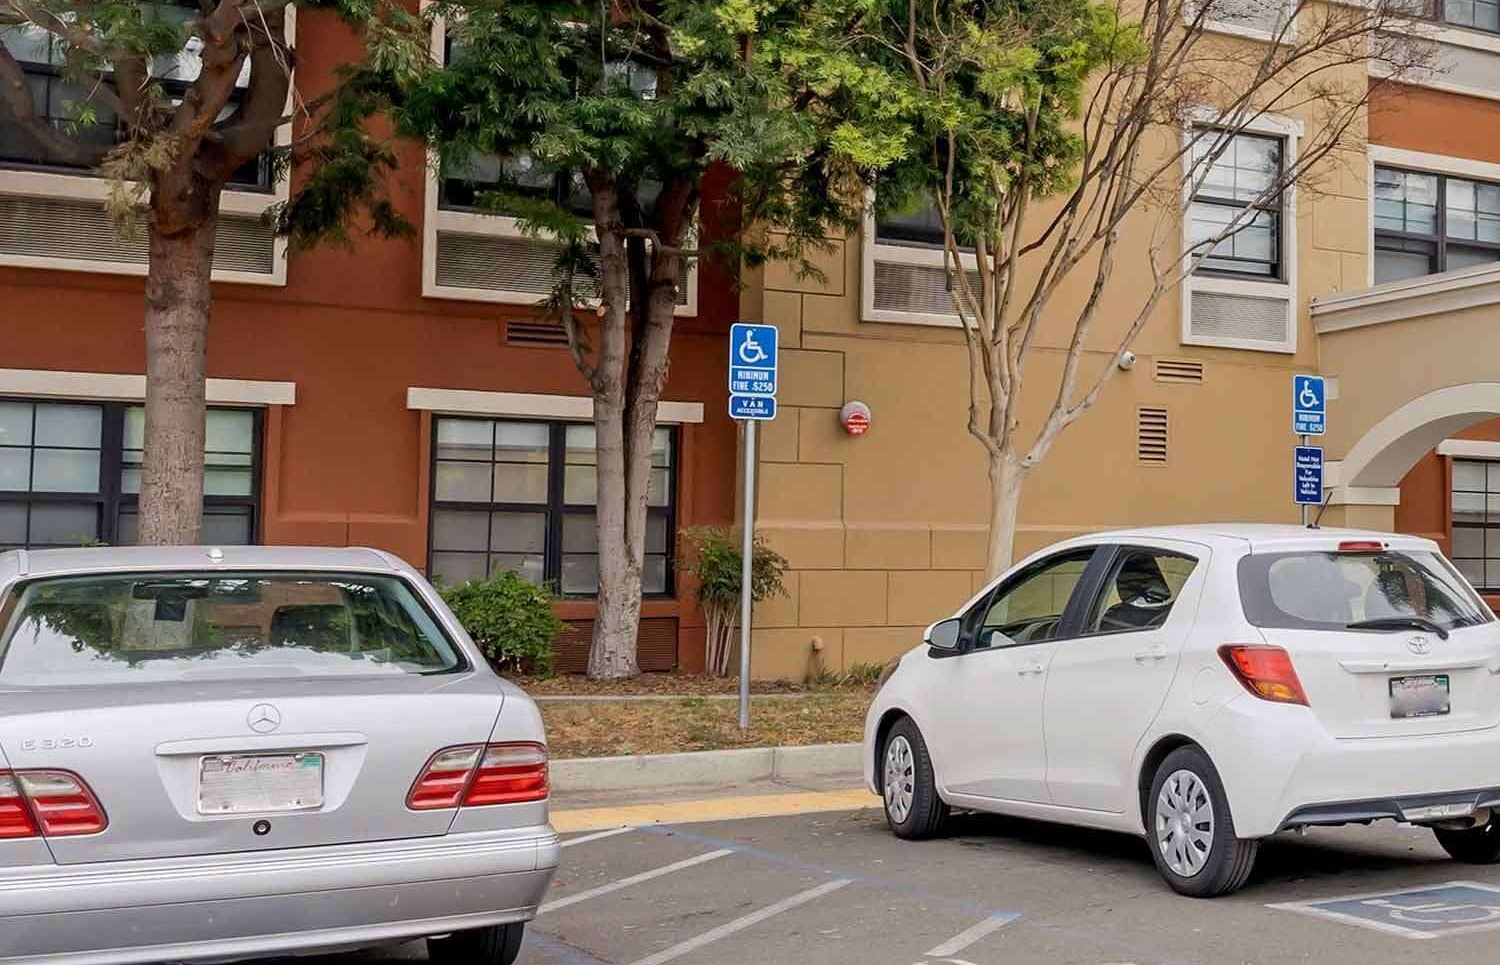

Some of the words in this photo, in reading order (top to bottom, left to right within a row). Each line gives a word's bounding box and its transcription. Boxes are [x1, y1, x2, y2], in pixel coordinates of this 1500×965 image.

[751, 381, 774, 393] $250
[742, 400, 764, 408] VAN
[21, 738, 37, 751] E
[39, 734, 96, 751] 320
